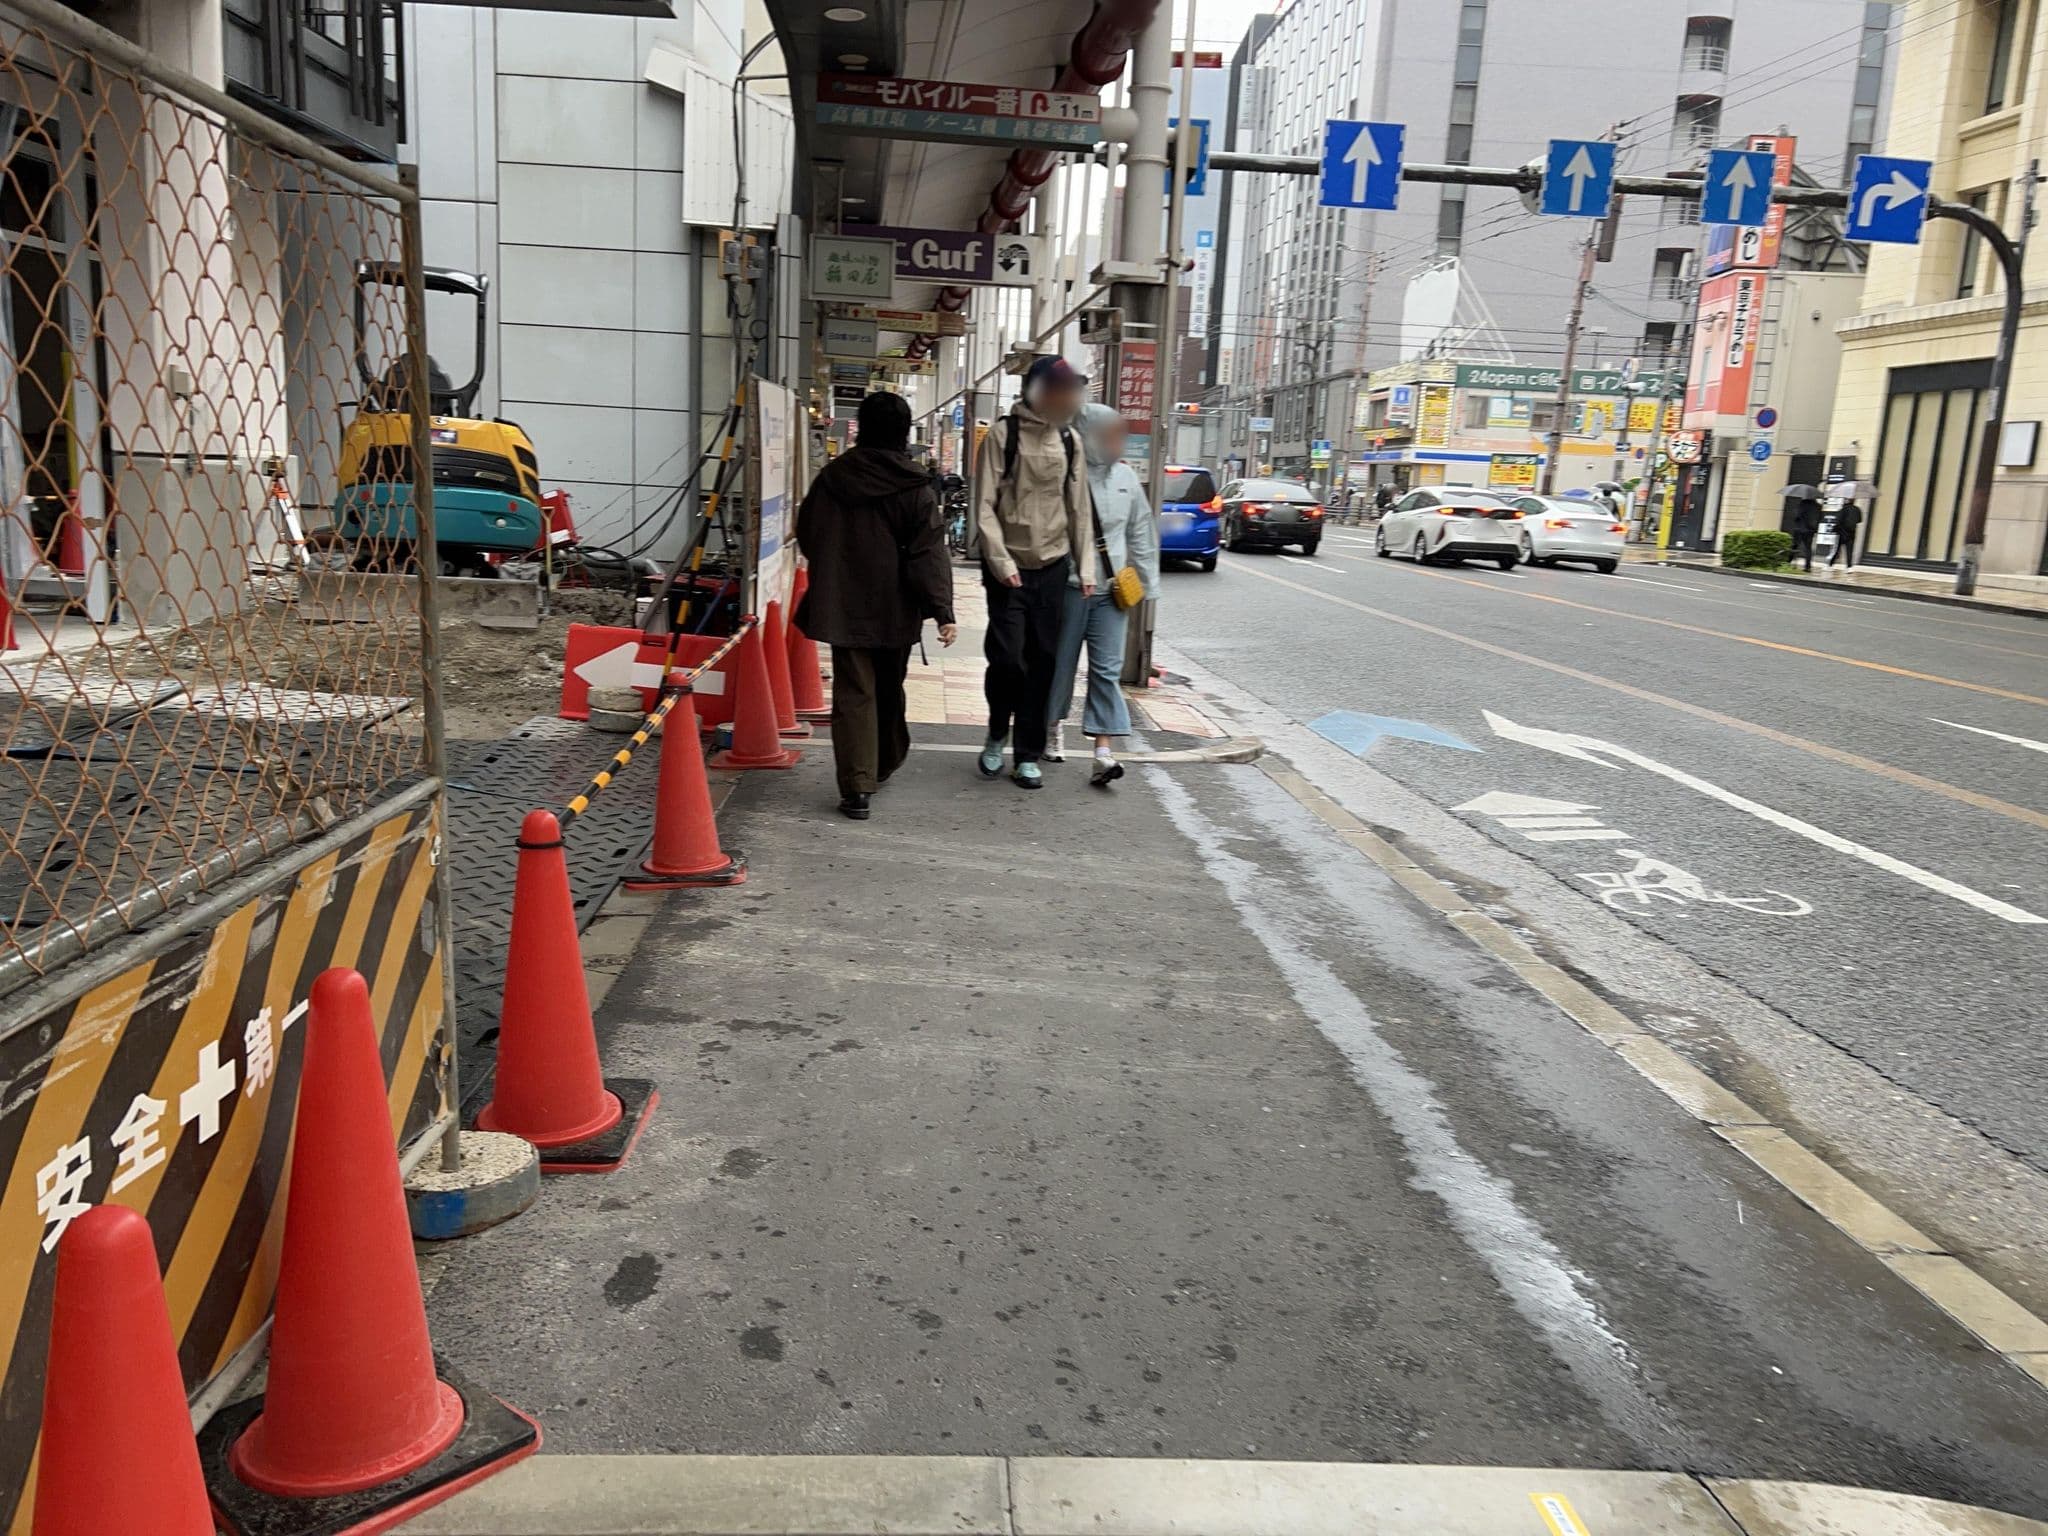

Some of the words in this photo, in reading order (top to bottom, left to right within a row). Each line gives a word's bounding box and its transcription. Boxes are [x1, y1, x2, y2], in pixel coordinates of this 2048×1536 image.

[876, 81, 1019, 115] モバイル一番
[911, 239, 983, 272] Guf
[36, 1093, 168, 1254] 安全
[244, 999, 309, 1098] 第一
